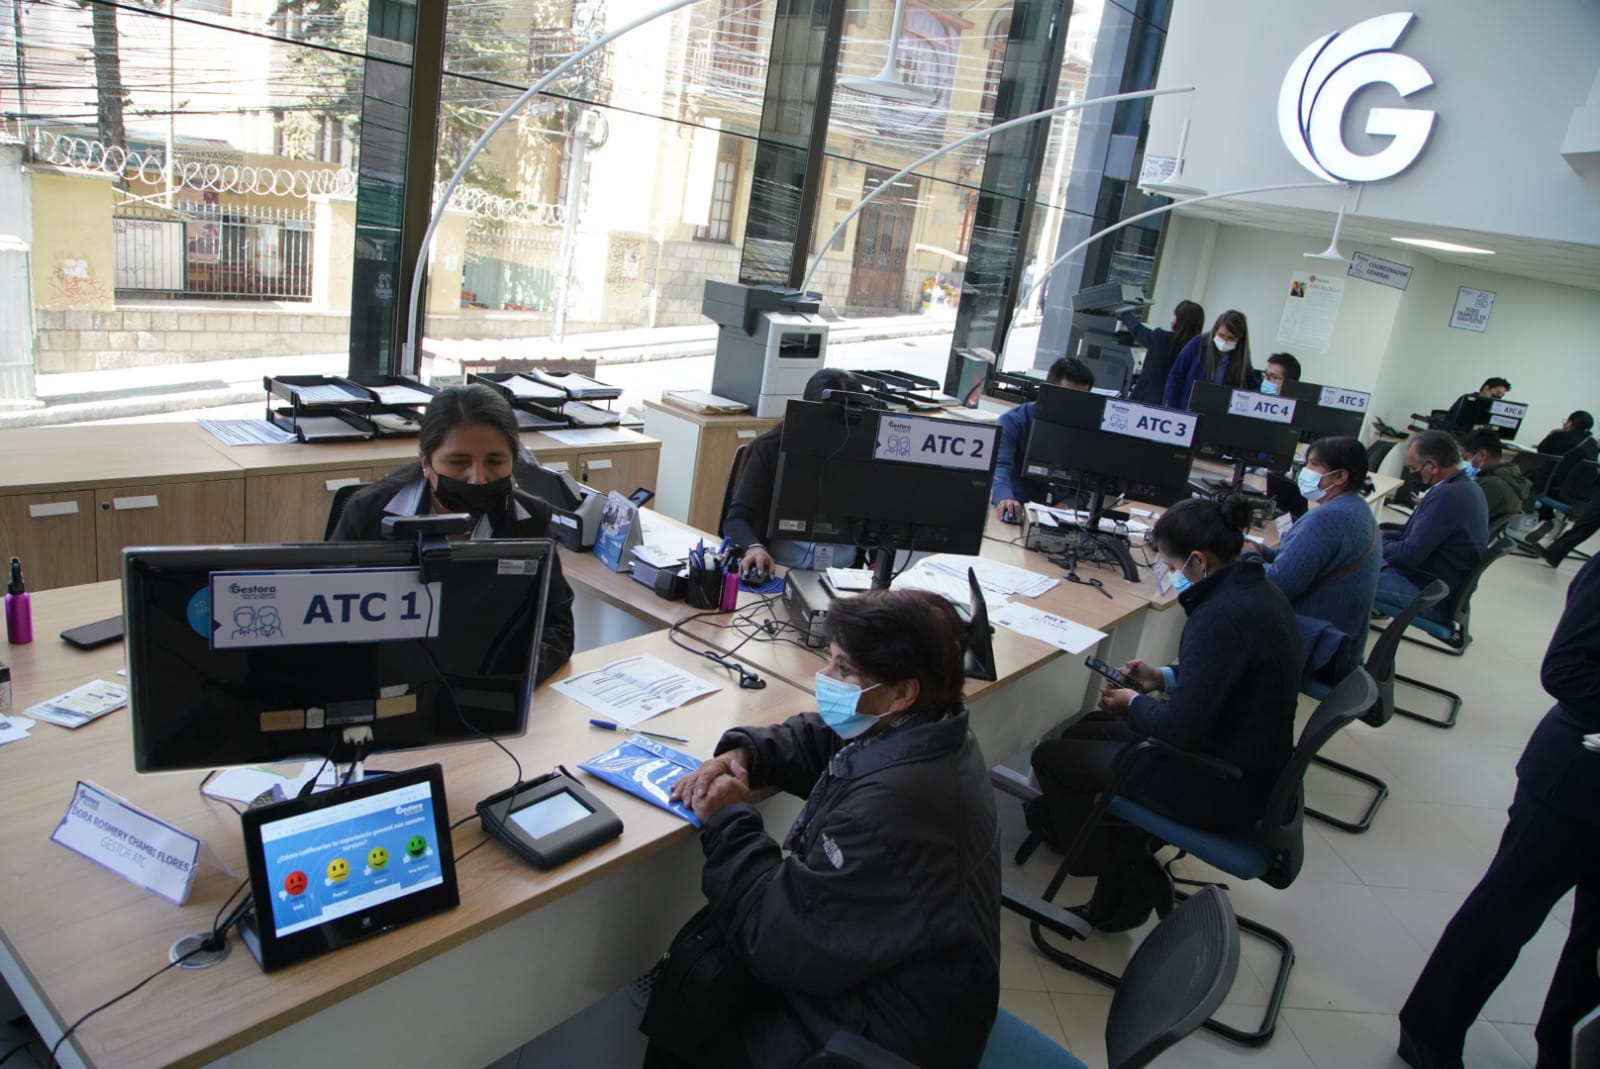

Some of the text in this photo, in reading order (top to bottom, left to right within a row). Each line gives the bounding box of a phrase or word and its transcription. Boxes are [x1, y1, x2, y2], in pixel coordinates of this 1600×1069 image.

[1278, 12, 1437, 183] G
[1254, 401, 1289, 416] ATC 4
[1338, 395, 1365, 407] ATC 5
[888, 421, 911, 430] Gestora
[1136, 415, 1187, 436] ATC 3
[921, 434, 984, 458] ATC 2
[229, 583, 276, 594] Gestora
[303, 591, 421, 624] ATC 1
[72, 806, 93, 823] DORA
[94, 816, 129, 841] ROSMERY
[156, 851, 190, 873] FLORES
